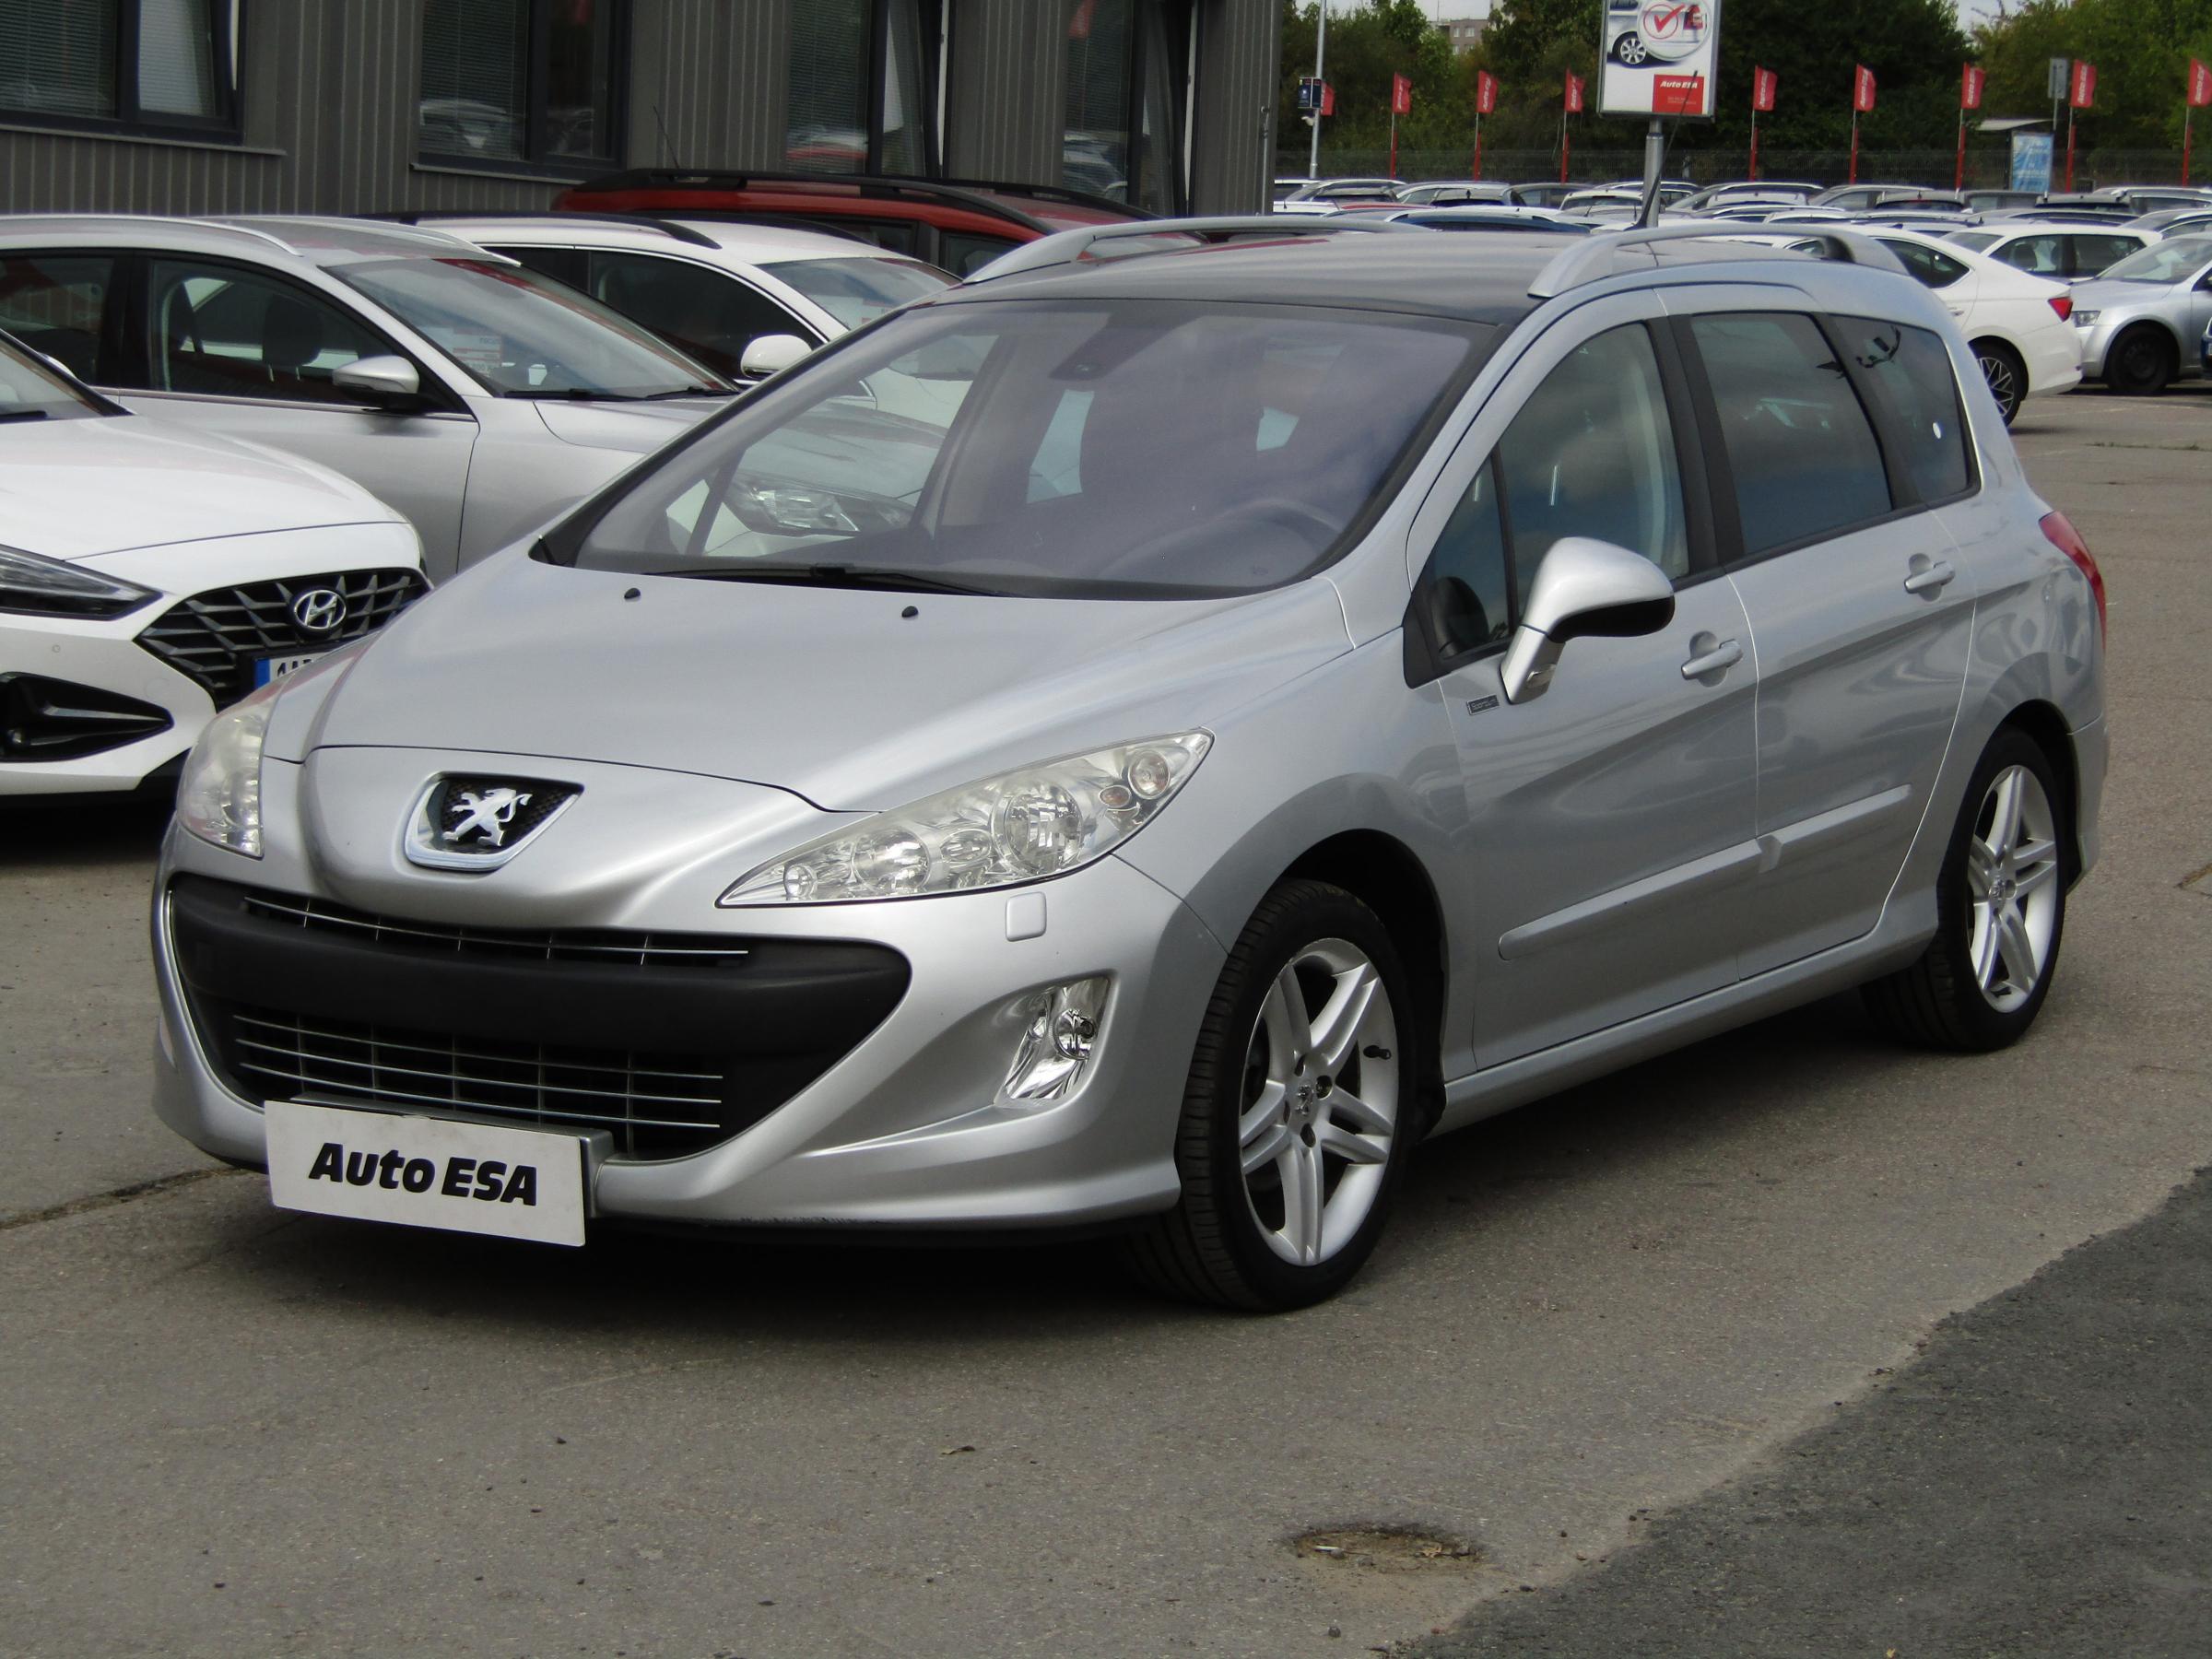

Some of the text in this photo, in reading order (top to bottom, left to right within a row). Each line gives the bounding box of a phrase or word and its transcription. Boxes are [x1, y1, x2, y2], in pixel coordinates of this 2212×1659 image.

[1660, 80, 1682, 88] Auto
[308, 1142, 537, 1206] Auto ESA
